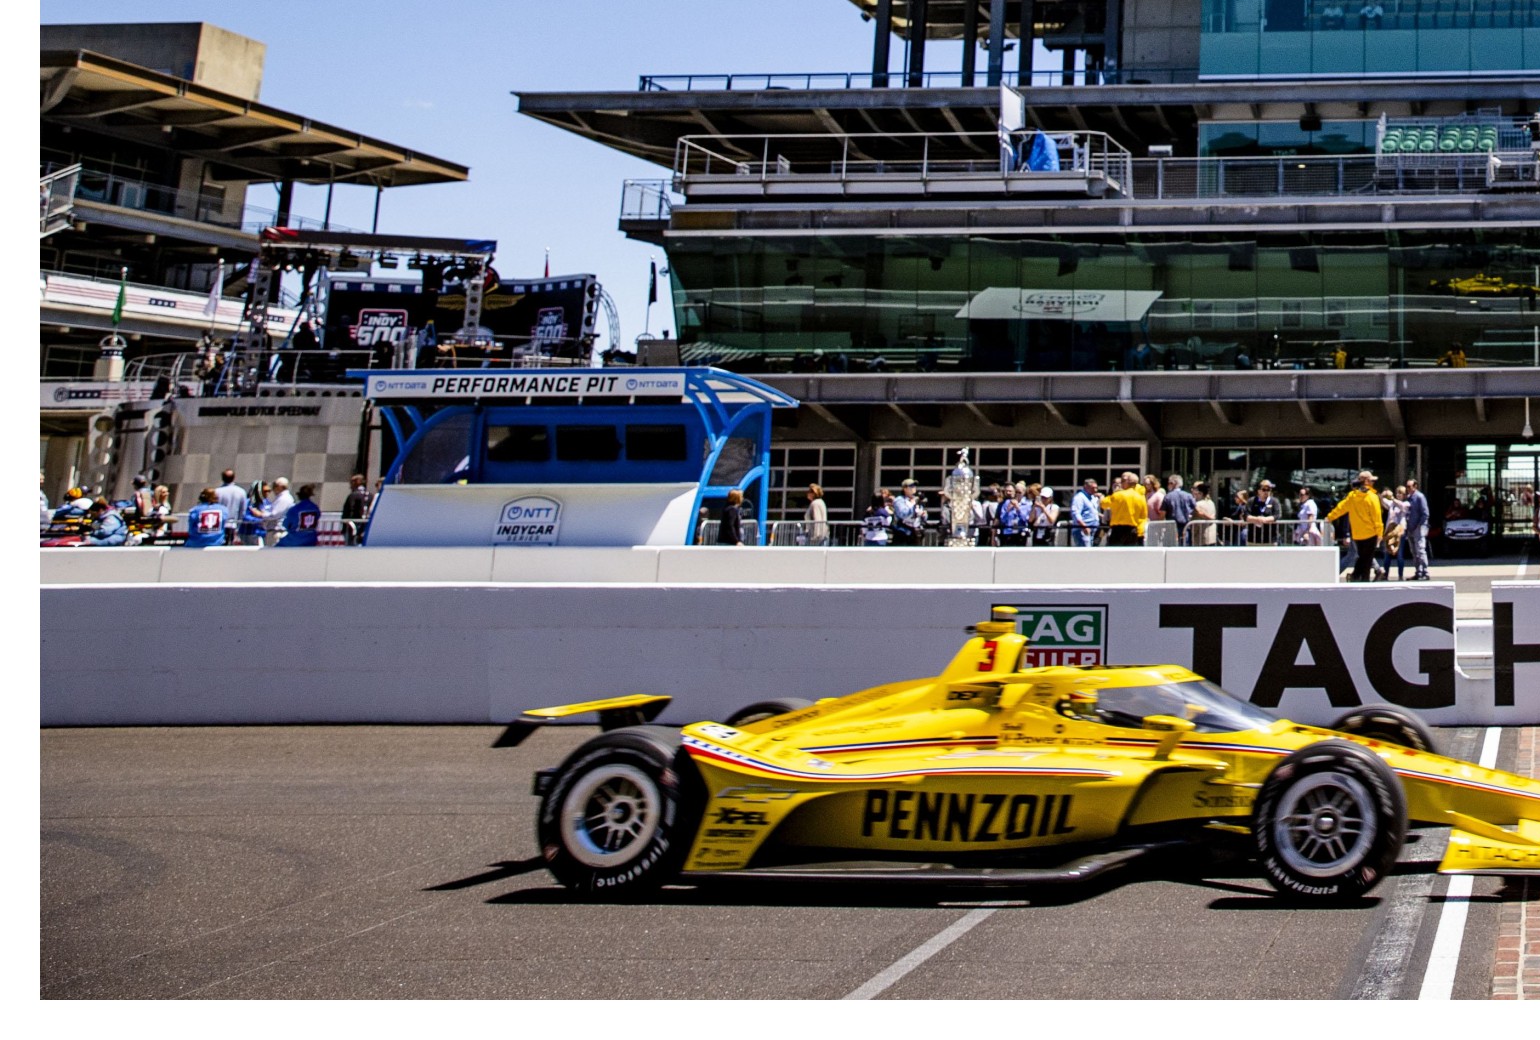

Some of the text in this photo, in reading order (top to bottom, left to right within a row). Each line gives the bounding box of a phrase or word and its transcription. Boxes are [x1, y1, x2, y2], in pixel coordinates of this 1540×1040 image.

[367, 316, 398, 326] INDY
[357, 326, 406, 346] 500
[431, 376, 619, 393] PERFORMANCE PIT
[524, 508, 552, 518] NTT
[496, 525, 554, 535] INDYCAR
[977, 640, 998, 671] 3
[862, 789, 1077, 842] PENNZOIL
